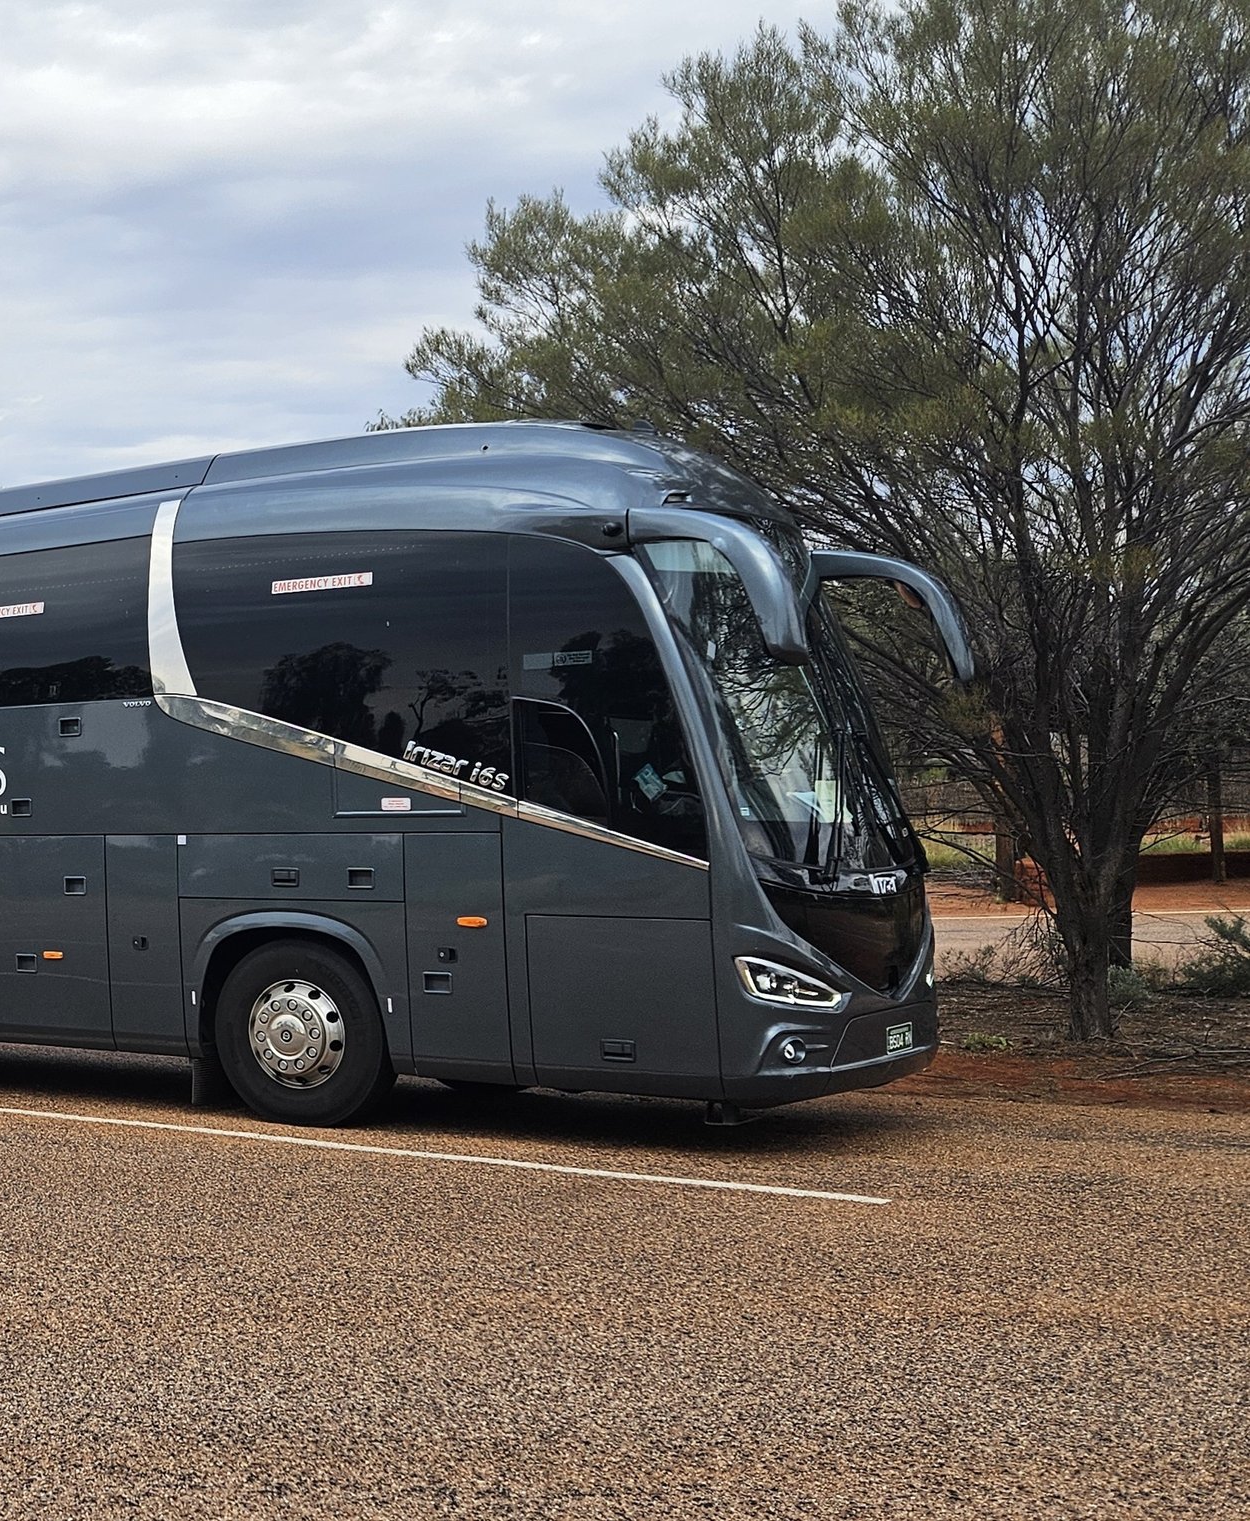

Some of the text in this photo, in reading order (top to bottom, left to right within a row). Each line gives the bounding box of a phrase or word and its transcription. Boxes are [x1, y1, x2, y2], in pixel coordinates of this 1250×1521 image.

[273, 575, 354, 593] EMERGENCY EXIT
[12, 605, 29, 615] EXIT
[122, 700, 152, 708] VOLVO
